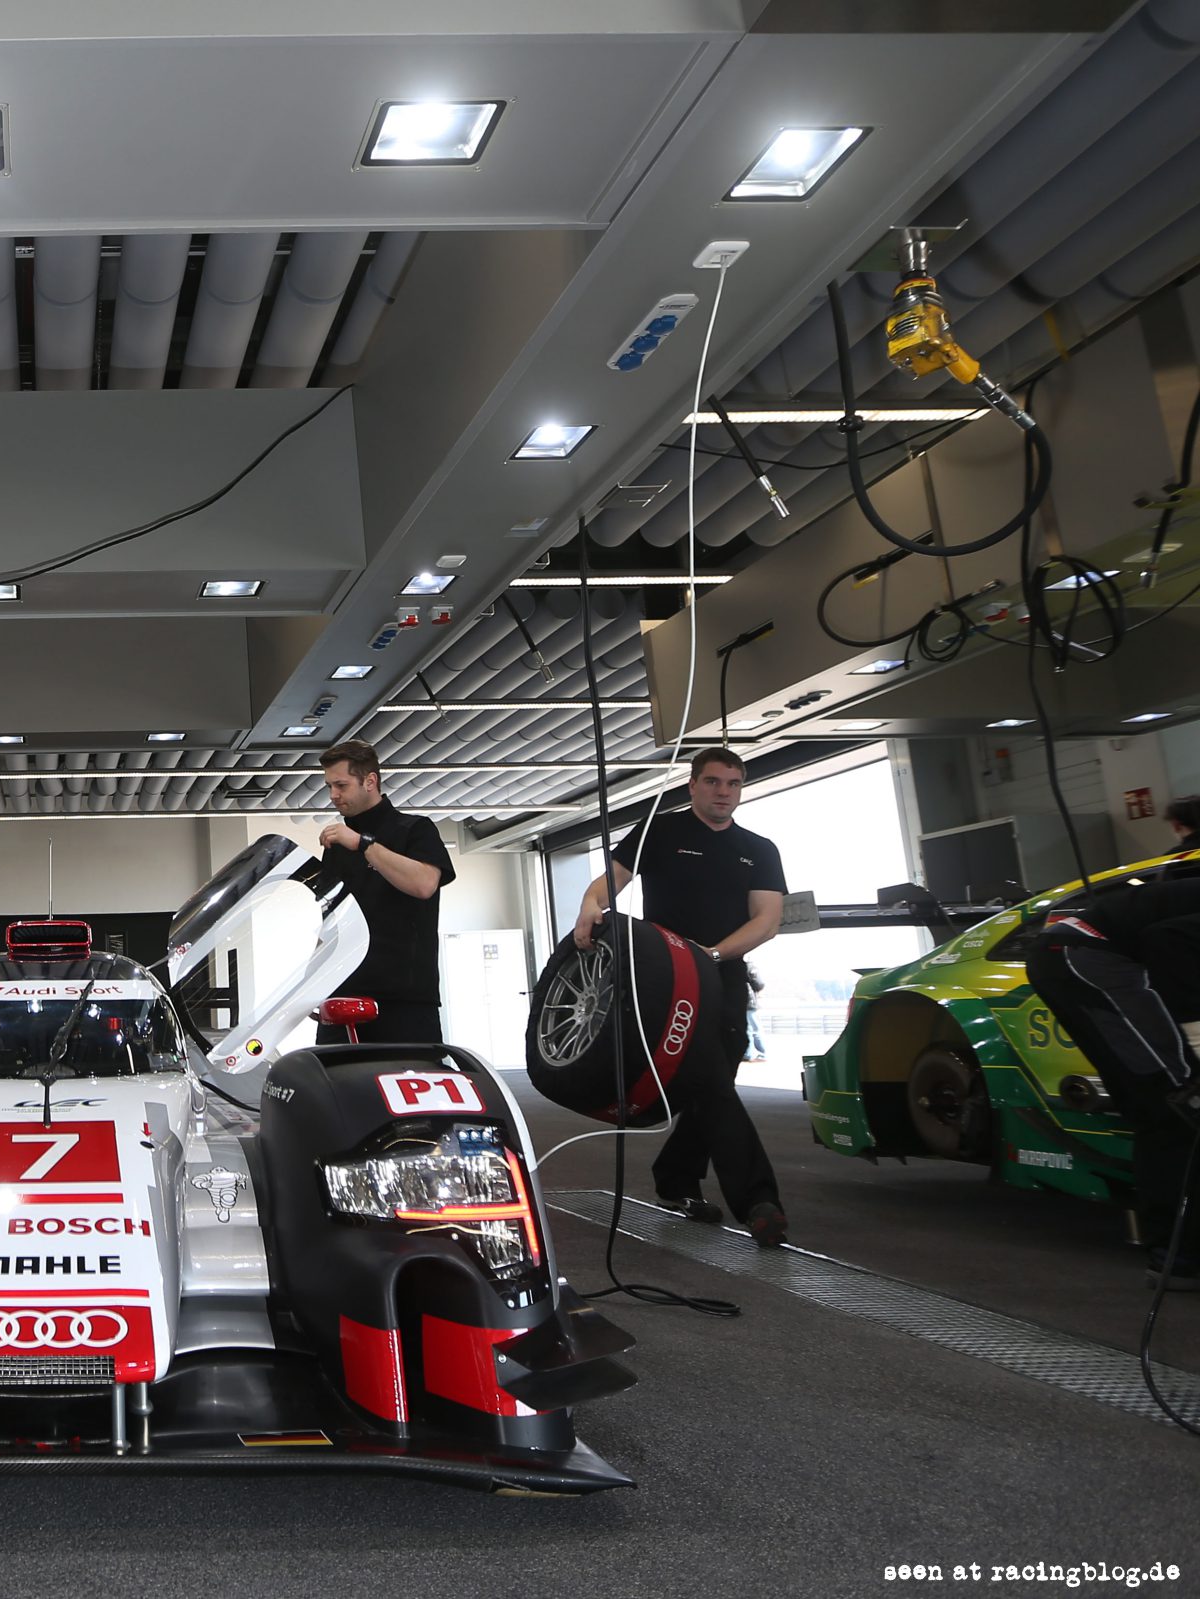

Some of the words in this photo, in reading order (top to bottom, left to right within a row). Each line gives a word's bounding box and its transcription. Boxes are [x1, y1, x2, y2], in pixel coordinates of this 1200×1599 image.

[4, 986, 57, 996] Audi
[396, 1078, 466, 1105] P1
[11, 1133, 80, 1180] 7
[8, 1217, 151, 1238] BOSCH
